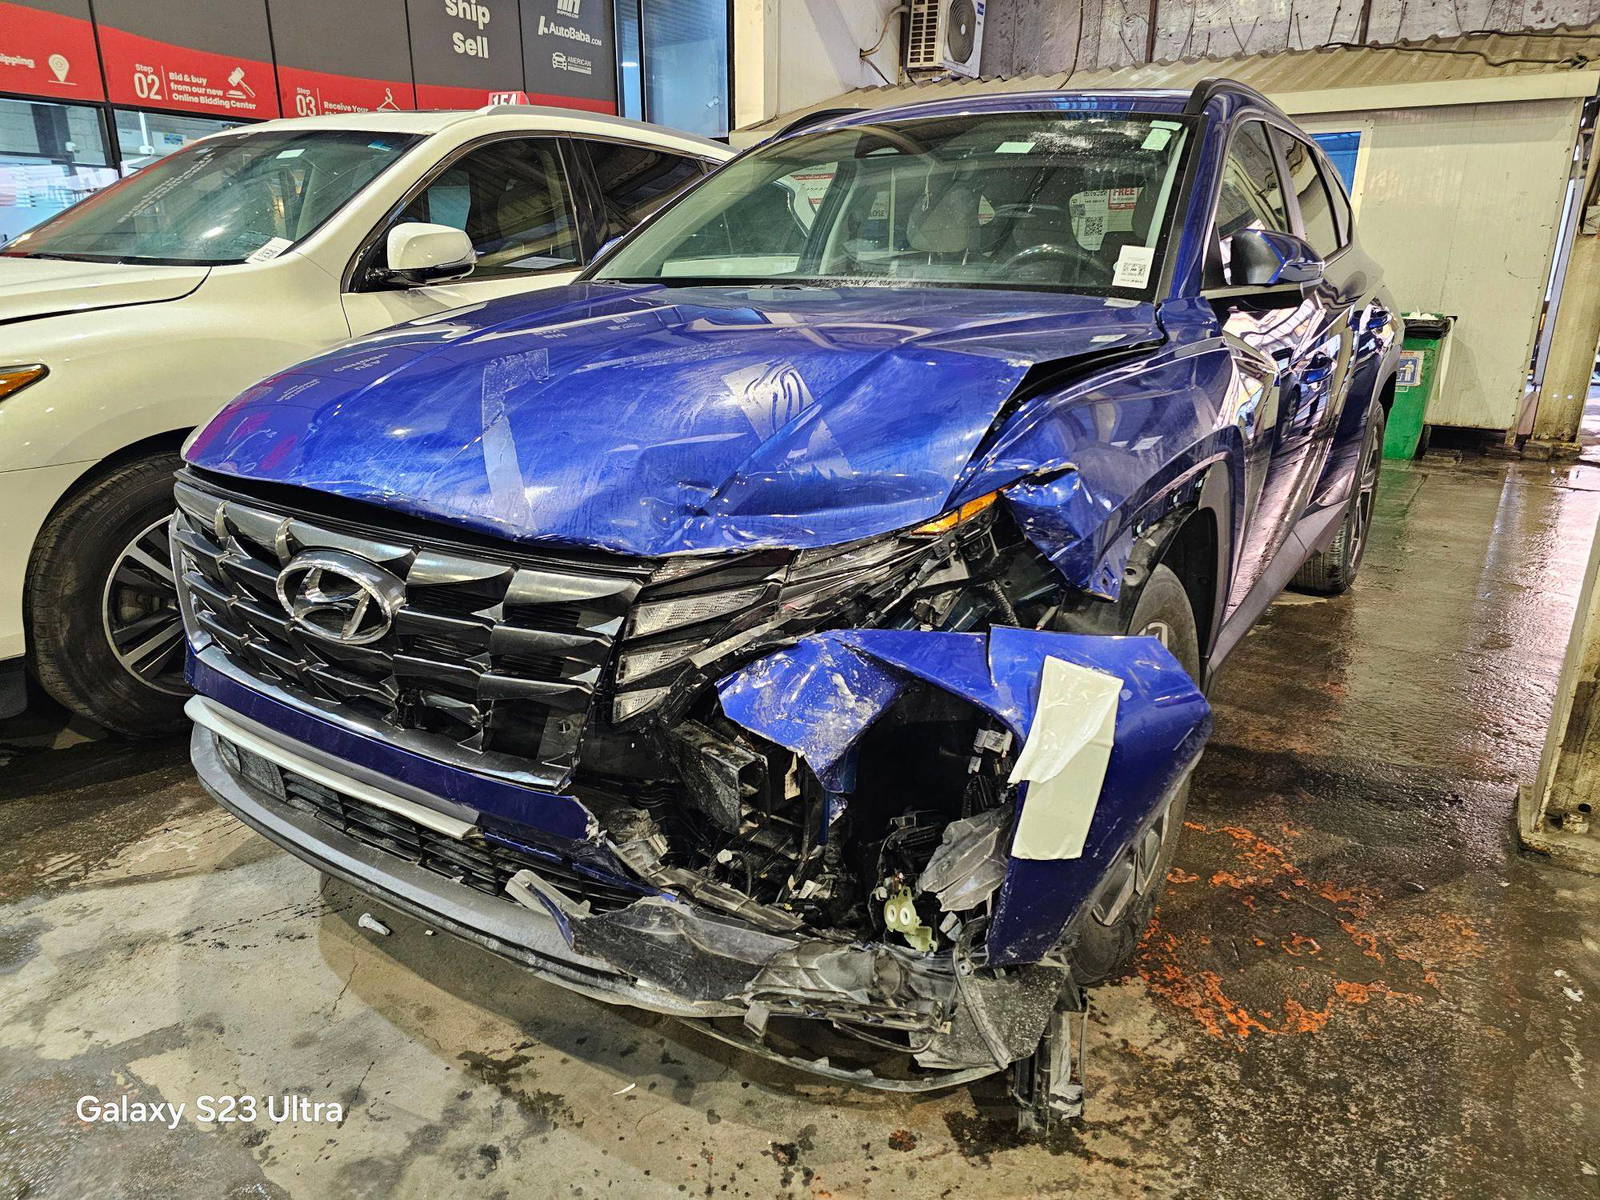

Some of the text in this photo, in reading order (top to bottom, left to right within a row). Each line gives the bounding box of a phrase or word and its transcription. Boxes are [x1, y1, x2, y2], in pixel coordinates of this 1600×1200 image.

[445, 0, 491, 30] Ship
[452, 32, 489, 59] Sell
[135, 63, 154, 75] Step
[133, 72, 162, 100] 02
[168, 72, 207, 86] Bid & buy
[170, 82, 224, 97] from our new
[296, 87, 311, 97] Step
[172, 93, 257, 110] Online Bidding Center
[295, 94, 317, 117] 03
[323, 101, 369, 113] Receive Your
[1112, 188, 1135, 196] FREE
